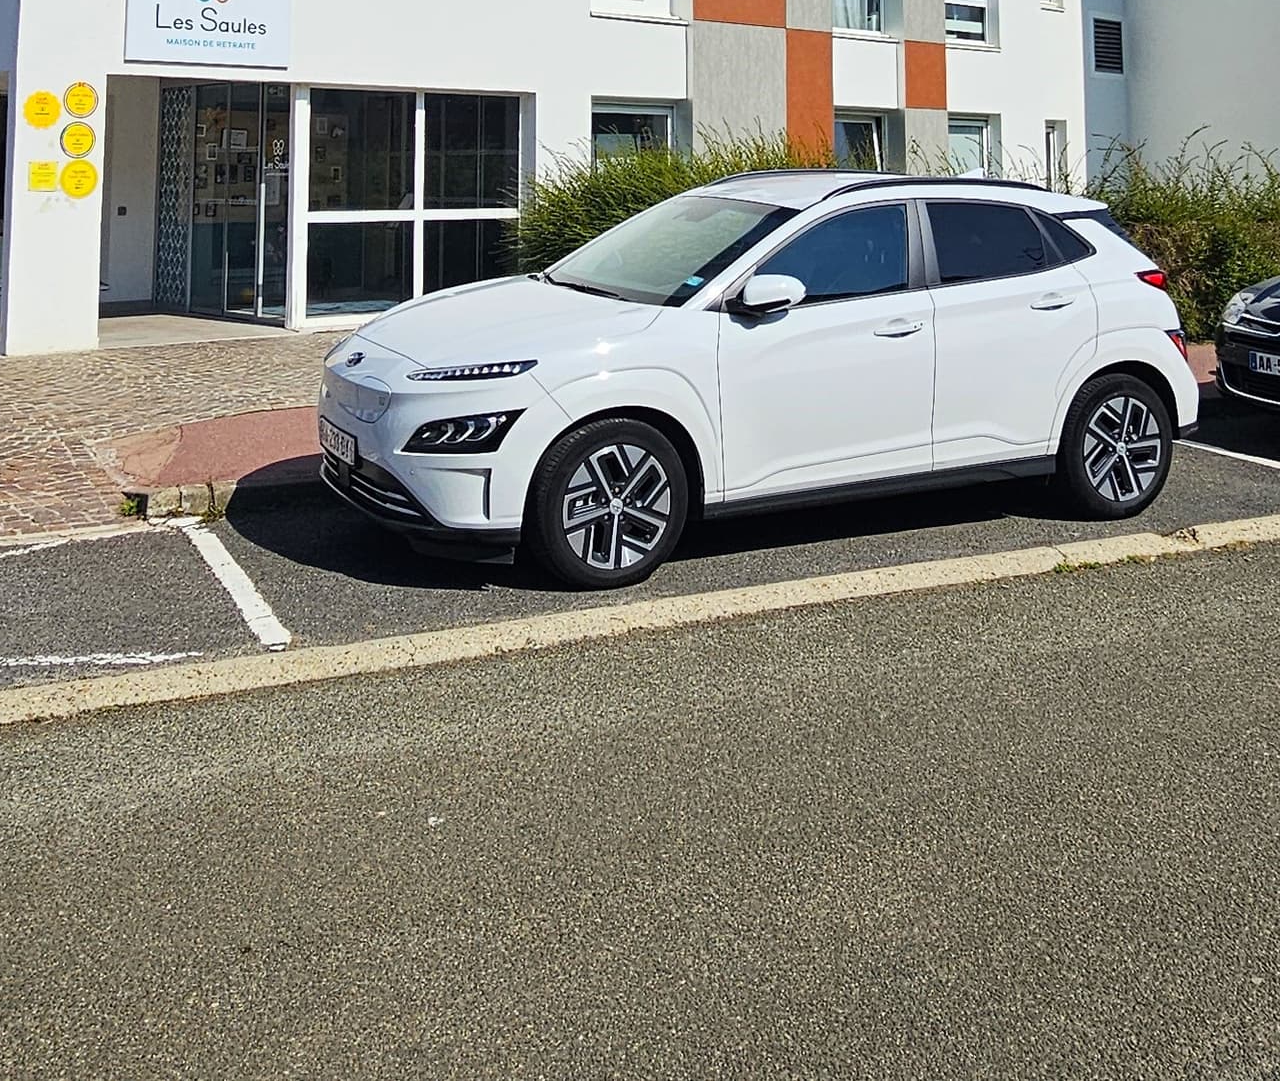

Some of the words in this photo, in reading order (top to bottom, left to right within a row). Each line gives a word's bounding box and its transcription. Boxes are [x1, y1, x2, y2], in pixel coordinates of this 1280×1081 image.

[156, 3, 194, 31] Les
[200, 6, 267, 36] Saules
[166, 38, 201, 47] MAISON
[202, 40, 213, 48] DE
[216, 41, 257, 50] RETRAITE
